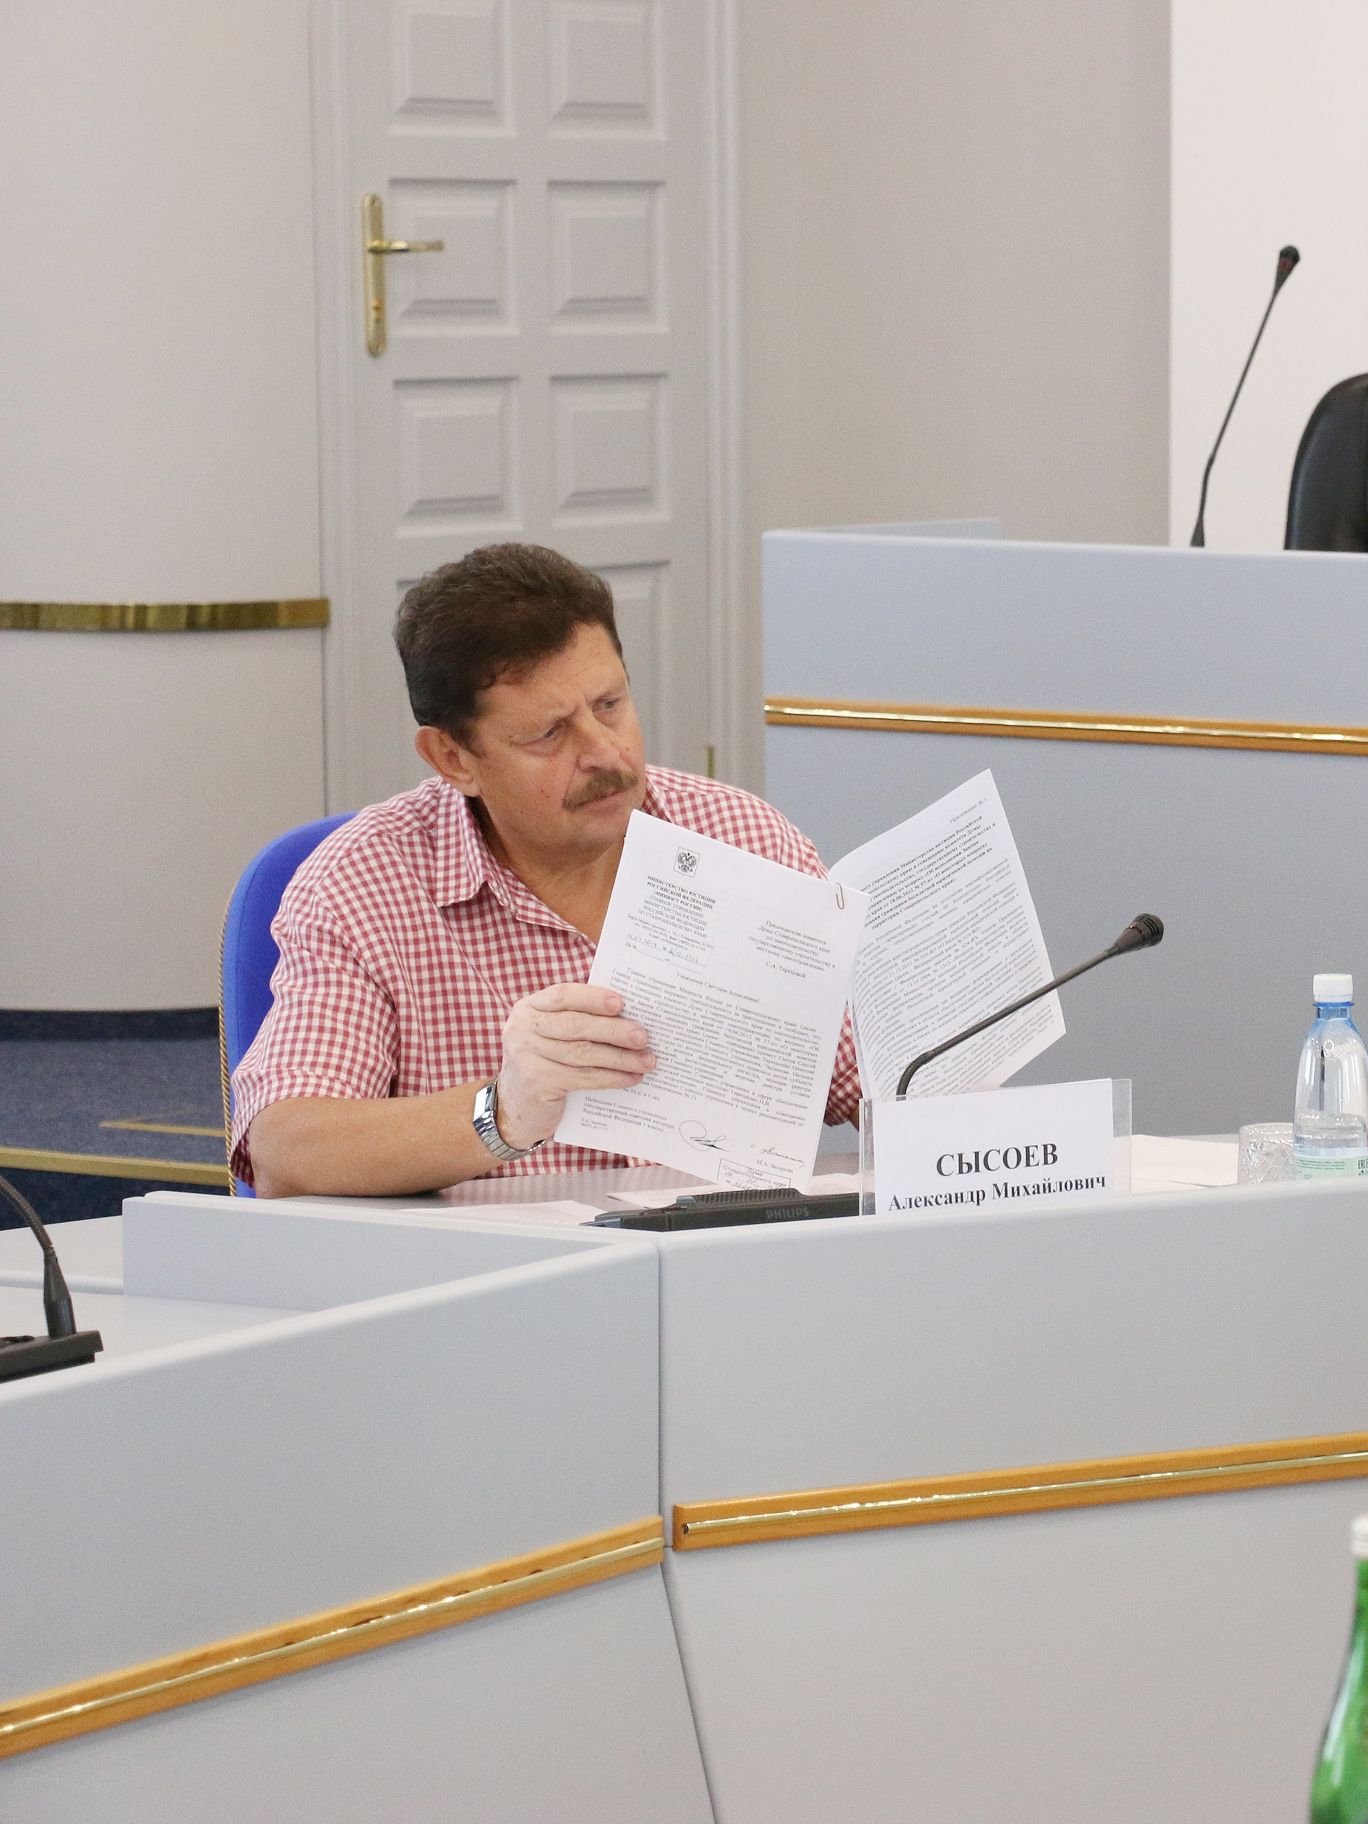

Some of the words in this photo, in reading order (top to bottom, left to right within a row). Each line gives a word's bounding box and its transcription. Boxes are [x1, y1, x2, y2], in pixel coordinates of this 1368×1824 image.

[936, 1143, 1059, 1177] СЫСОЕВ
[888, 1187, 986, 1212] Александр
[992, 1176, 1107, 1200] Михайлович
[766, 1207, 810, 1219] PHILIPS
